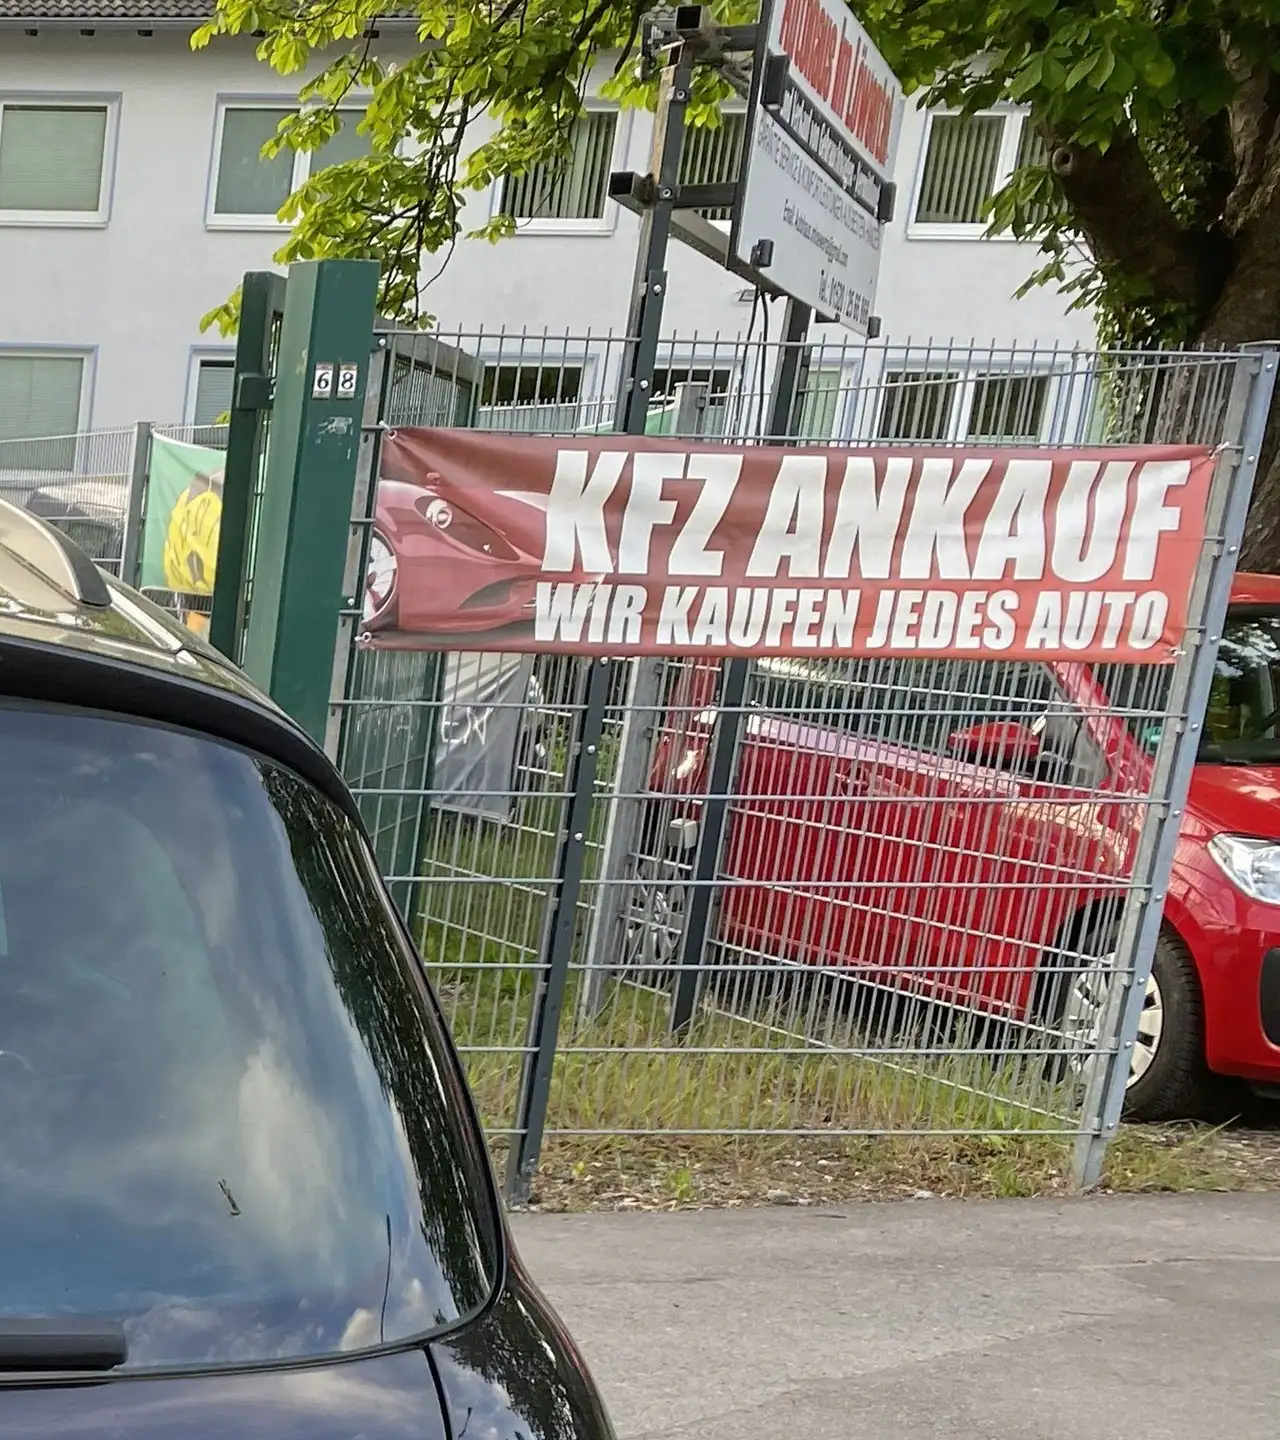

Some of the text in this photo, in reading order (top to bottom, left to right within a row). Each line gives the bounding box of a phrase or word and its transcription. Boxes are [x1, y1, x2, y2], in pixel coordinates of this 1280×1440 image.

[541, 450, 1191, 582] KFZ ANKAUF
[534, 581, 1167, 651] WIR KAUFEN JEDES AUTO
